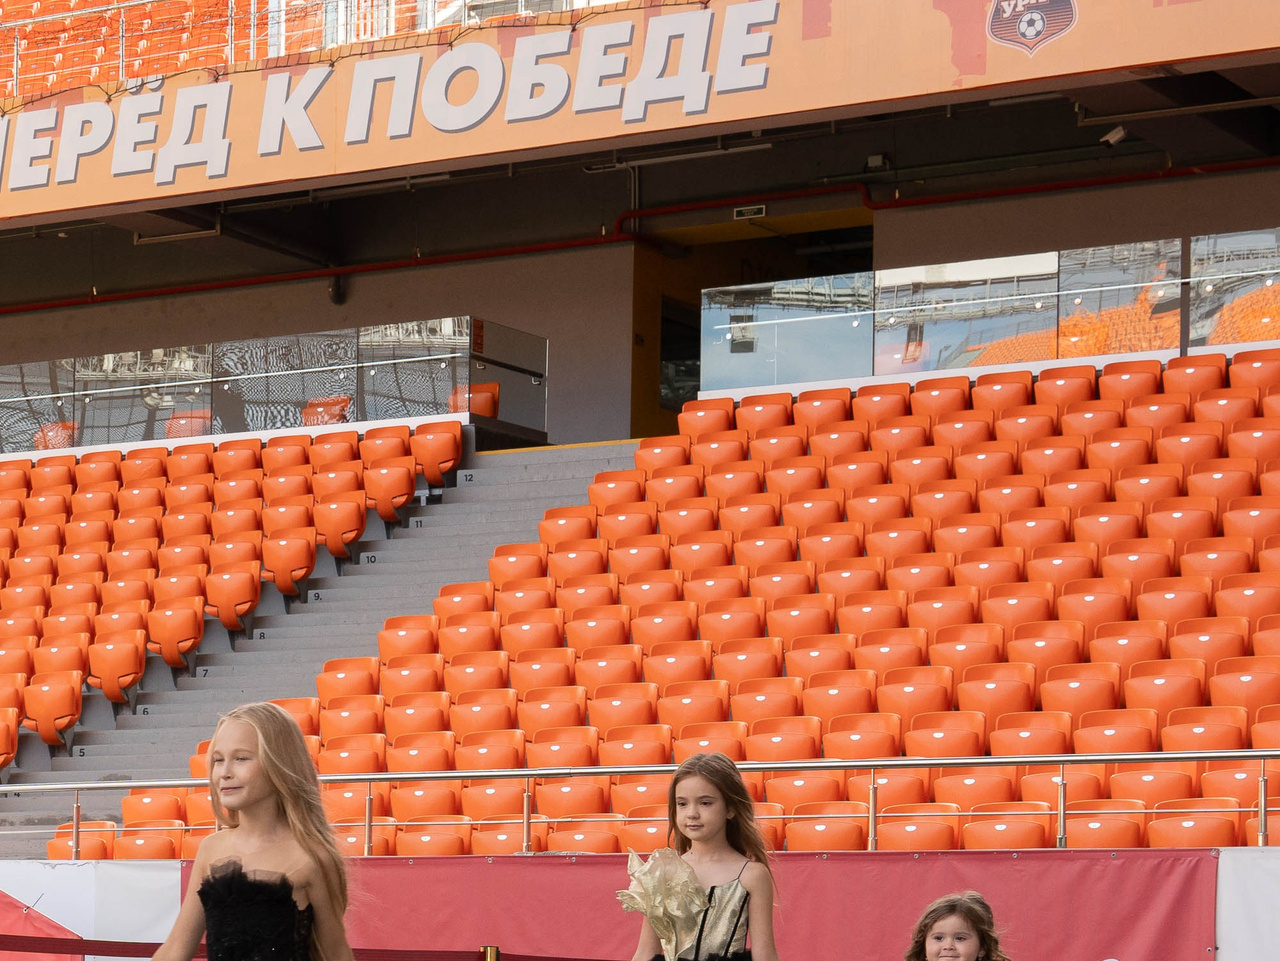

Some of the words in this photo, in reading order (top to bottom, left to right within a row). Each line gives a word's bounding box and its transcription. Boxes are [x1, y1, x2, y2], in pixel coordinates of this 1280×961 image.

[257, 67, 334, 157] К
[343, 0, 780, 146] ПОБЕДЕ
[464, 474, 474, 482] 12
[414, 520, 423, 528] 11
[366, 556, 377, 564] 10
[259, 632, 266, 640] 8
[202, 669, 209, 678] 7
[142, 707, 149, 716] 6
[78, 748, 86, 758] 5
